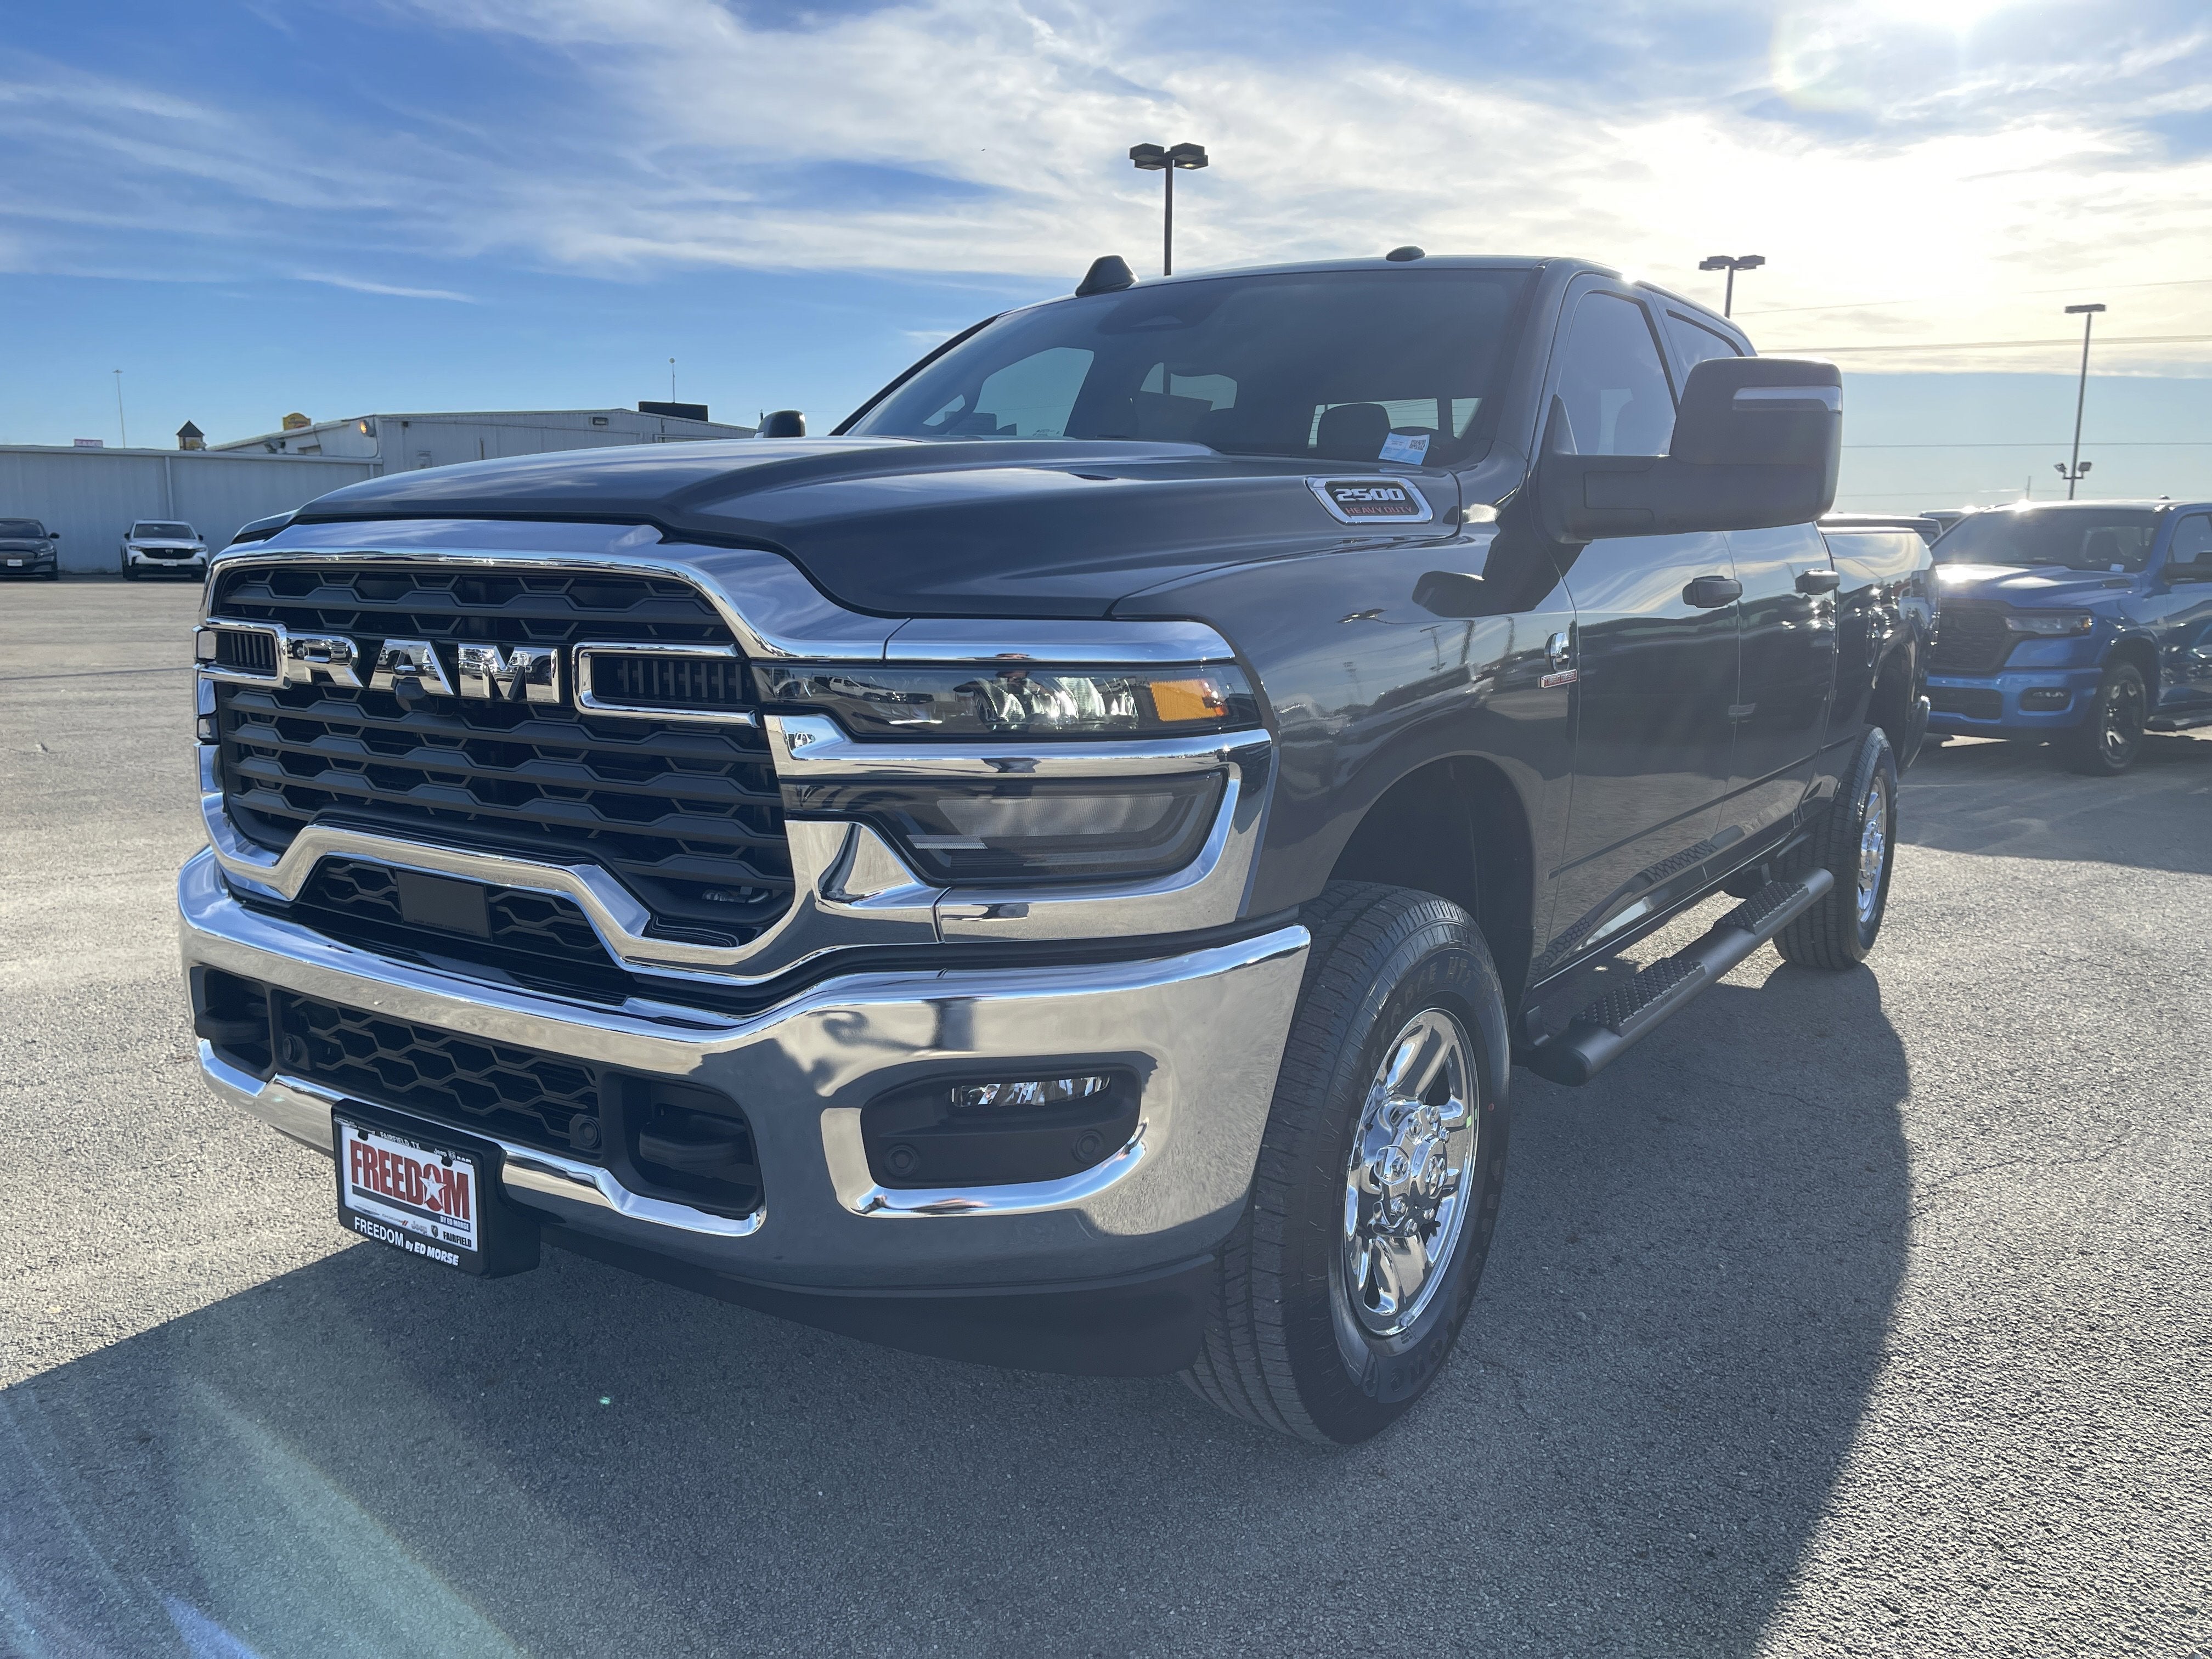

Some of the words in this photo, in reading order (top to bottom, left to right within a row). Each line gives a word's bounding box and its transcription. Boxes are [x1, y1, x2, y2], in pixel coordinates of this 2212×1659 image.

[1334, 488, 1406, 502] 2500
[1345, 506, 1382, 515] HEAVY
[1383, 506, 1412, 514] DUTY
[287, 632, 561, 704] RAM
[411, 1141, 420, 1150] TX
[350, 1139, 470, 1220] FREEDOM
[447, 1218, 453, 1226] ED
[453, 1220, 470, 1231] MORSE
[354, 1216, 404, 1248] FREEDOM
[414, 1242, 426, 1255] ED
[426, 1245, 459, 1266] MORSE
[443, 1231, 472, 1248] FAIRFIELD
